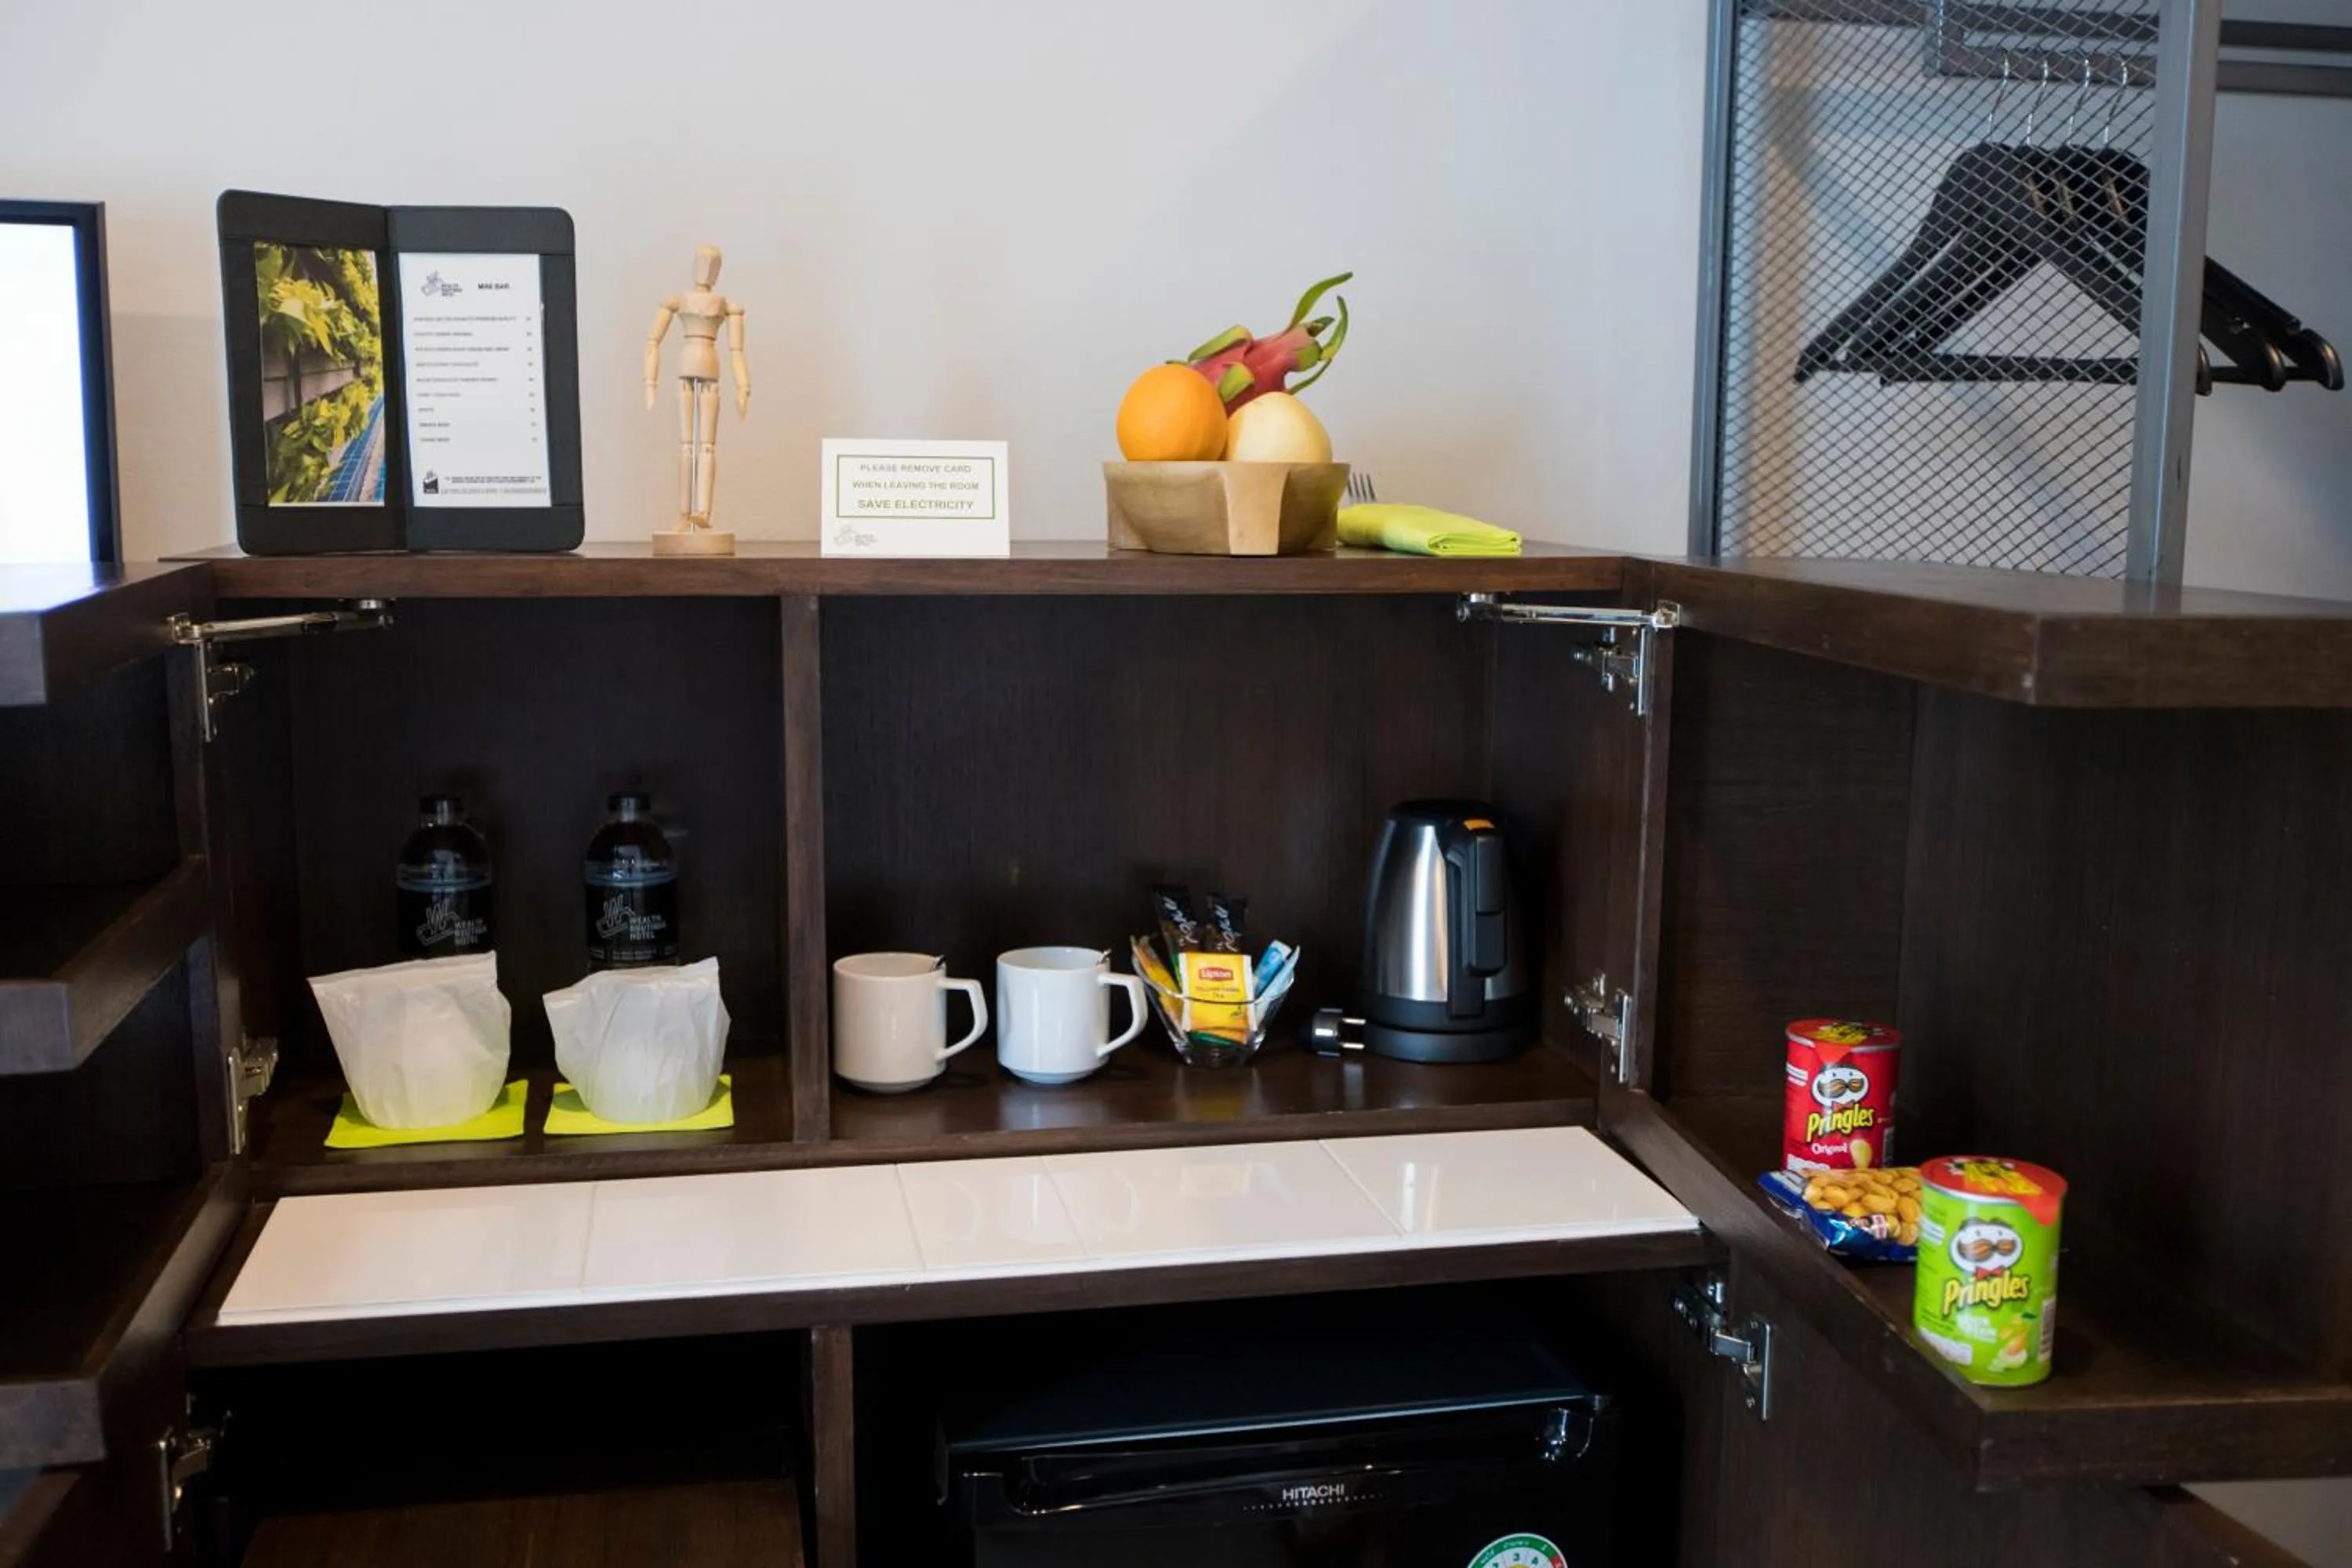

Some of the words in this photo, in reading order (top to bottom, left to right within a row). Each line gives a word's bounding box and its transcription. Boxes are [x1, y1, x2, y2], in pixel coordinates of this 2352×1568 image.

[860, 463, 898, 472] PLEASE
[901, 464, 941, 473] REMOVE
[884, 481, 926, 490] LEAVING
[929, 481, 947, 490] THE
[858, 499, 891, 509] SAVE
[895, 499, 974, 509] ELECTRICITY
[1201, 969, 1232, 979] Lipton
[1806, 1103, 1875, 1142] Pringles
[1944, 1270, 2031, 1317] Pringles
[1282, 1484, 1345, 1501] HITACHI
[1513, 1552, 1520, 1562] 3
[1531, 1556, 1539, 1565] 4
